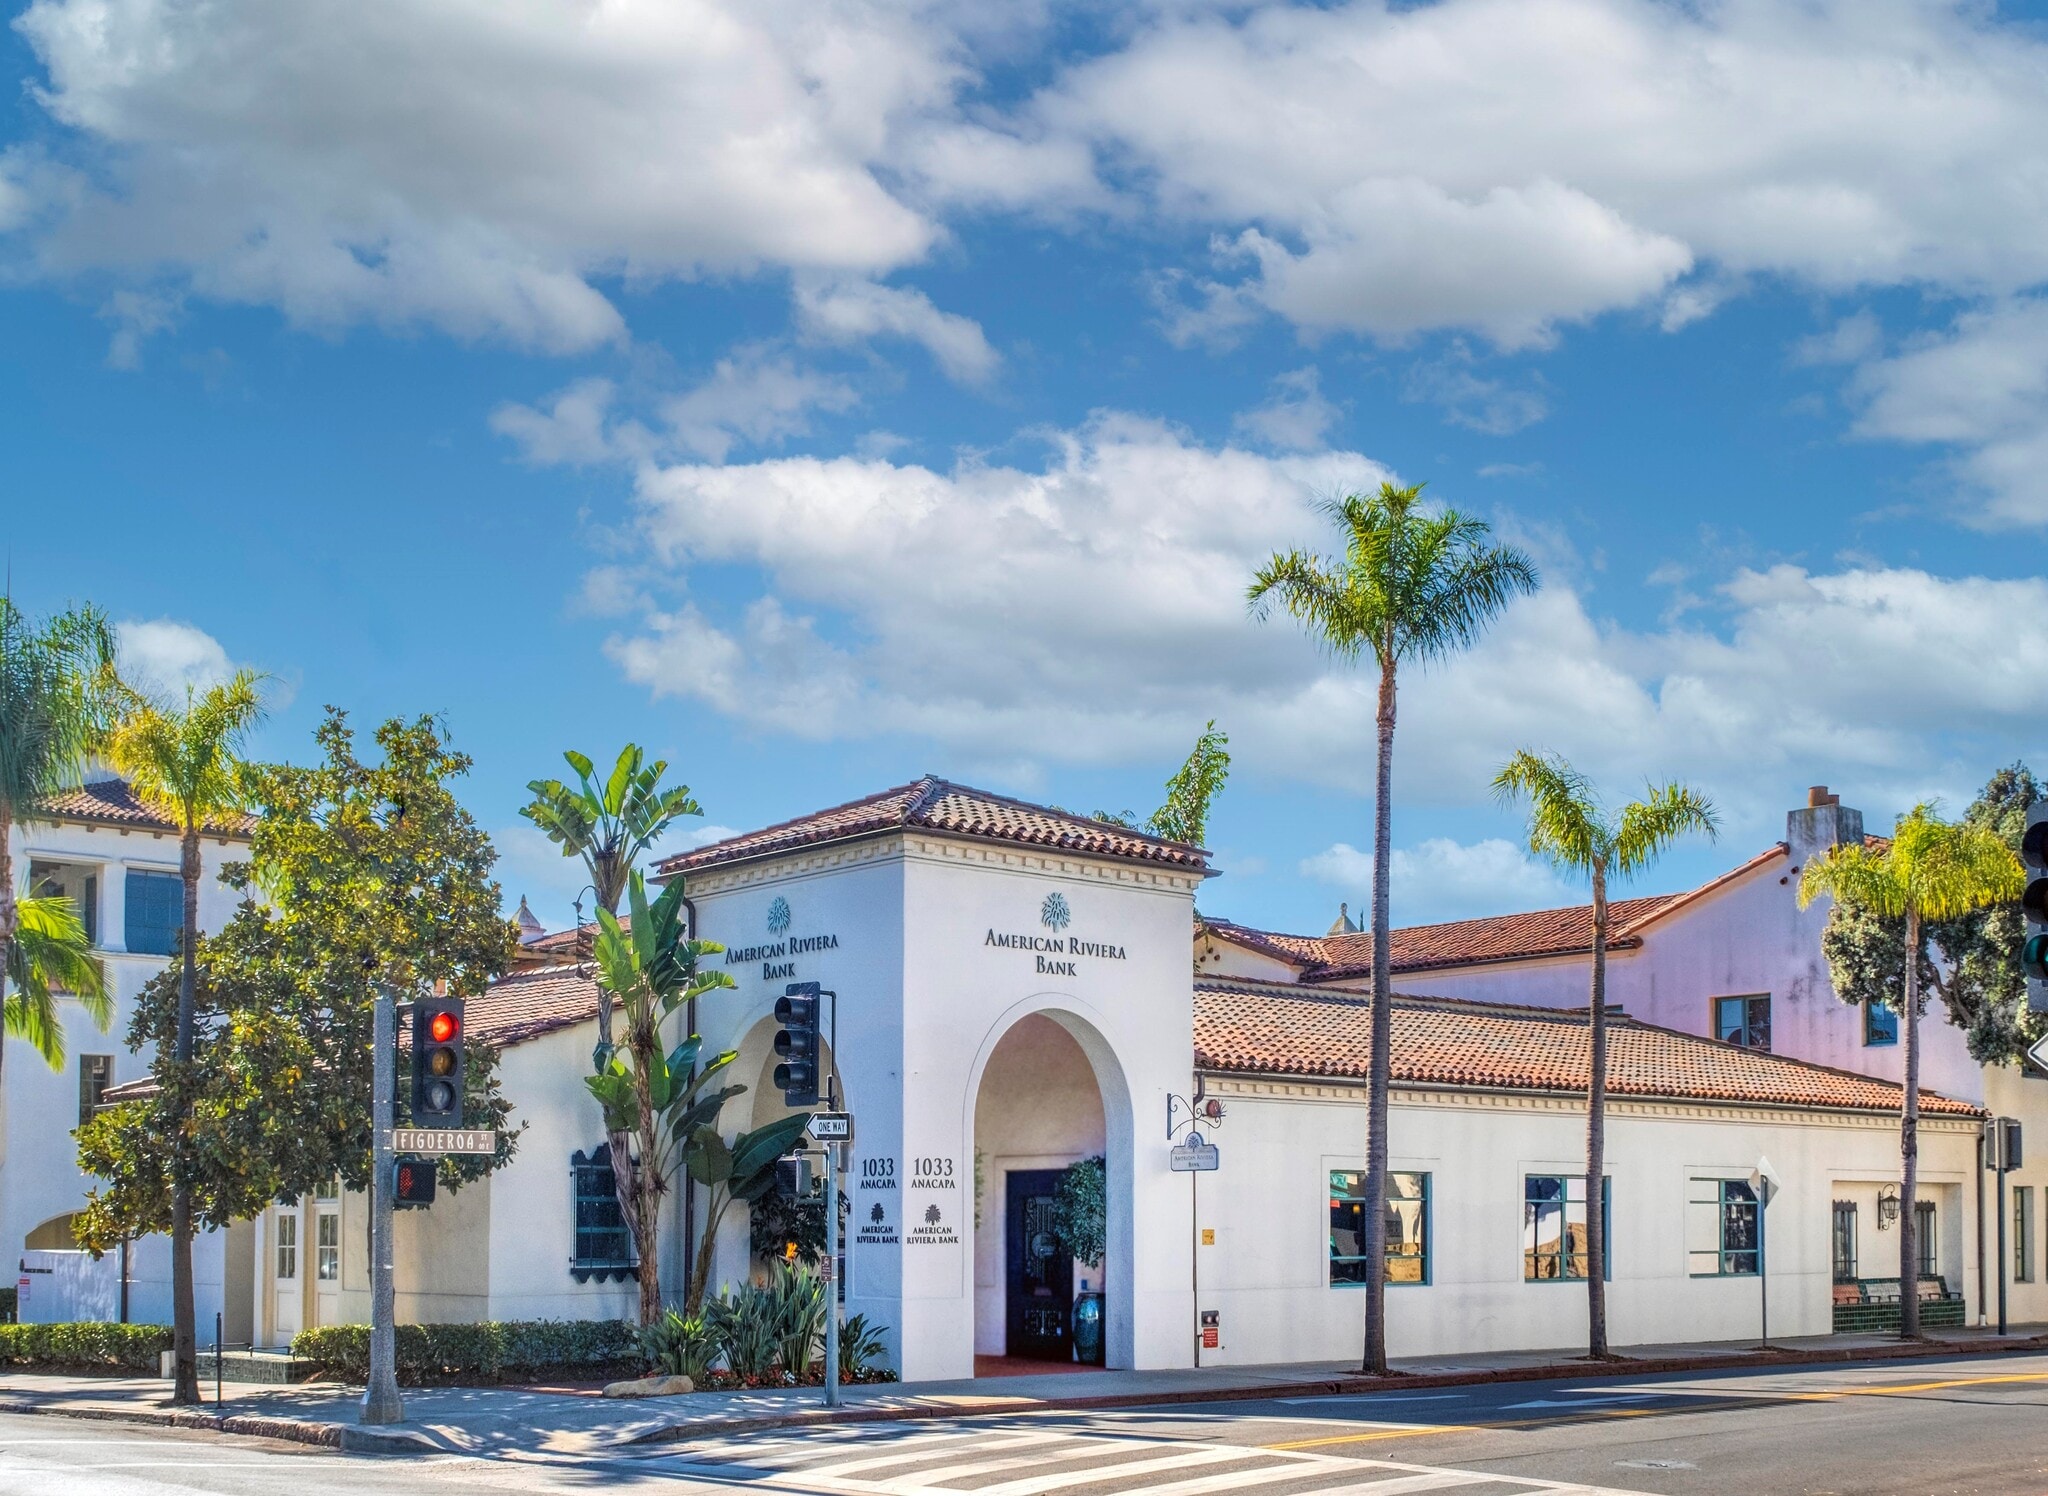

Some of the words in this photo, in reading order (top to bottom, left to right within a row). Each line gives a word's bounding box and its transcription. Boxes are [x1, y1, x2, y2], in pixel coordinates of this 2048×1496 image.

[725, 942, 785, 964] AMERICAN
[789, 934, 839, 955] RIVIERA
[985, 928, 1063, 952] AMERICAN
[1069, 937, 1126, 960] RIVIERA
[763, 962, 796, 980] BANK
[1036, 955, 1077, 976] BANK
[818, 1121, 831, 1132] ONE
[832, 1121, 846, 1132] WAY
[400, 1133, 474, 1149] FIGUEROA
[862, 1157, 894, 1177] 1033
[914, 1157, 953, 1176] 1033
[860, 1179, 897, 1189] ANACAPA
[911, 1179, 956, 1189] ANACAPA
[861, 1226, 893, 1234] AMERICAN
[912, 1227, 952, 1235] AMERICAN
[856, 1236, 881, 1244] RIVIERA
[882, 1236, 899, 1244] BANK
[906, 1236, 937, 1245] RIVIERA
[938, 1236, 959, 1244] BANK
